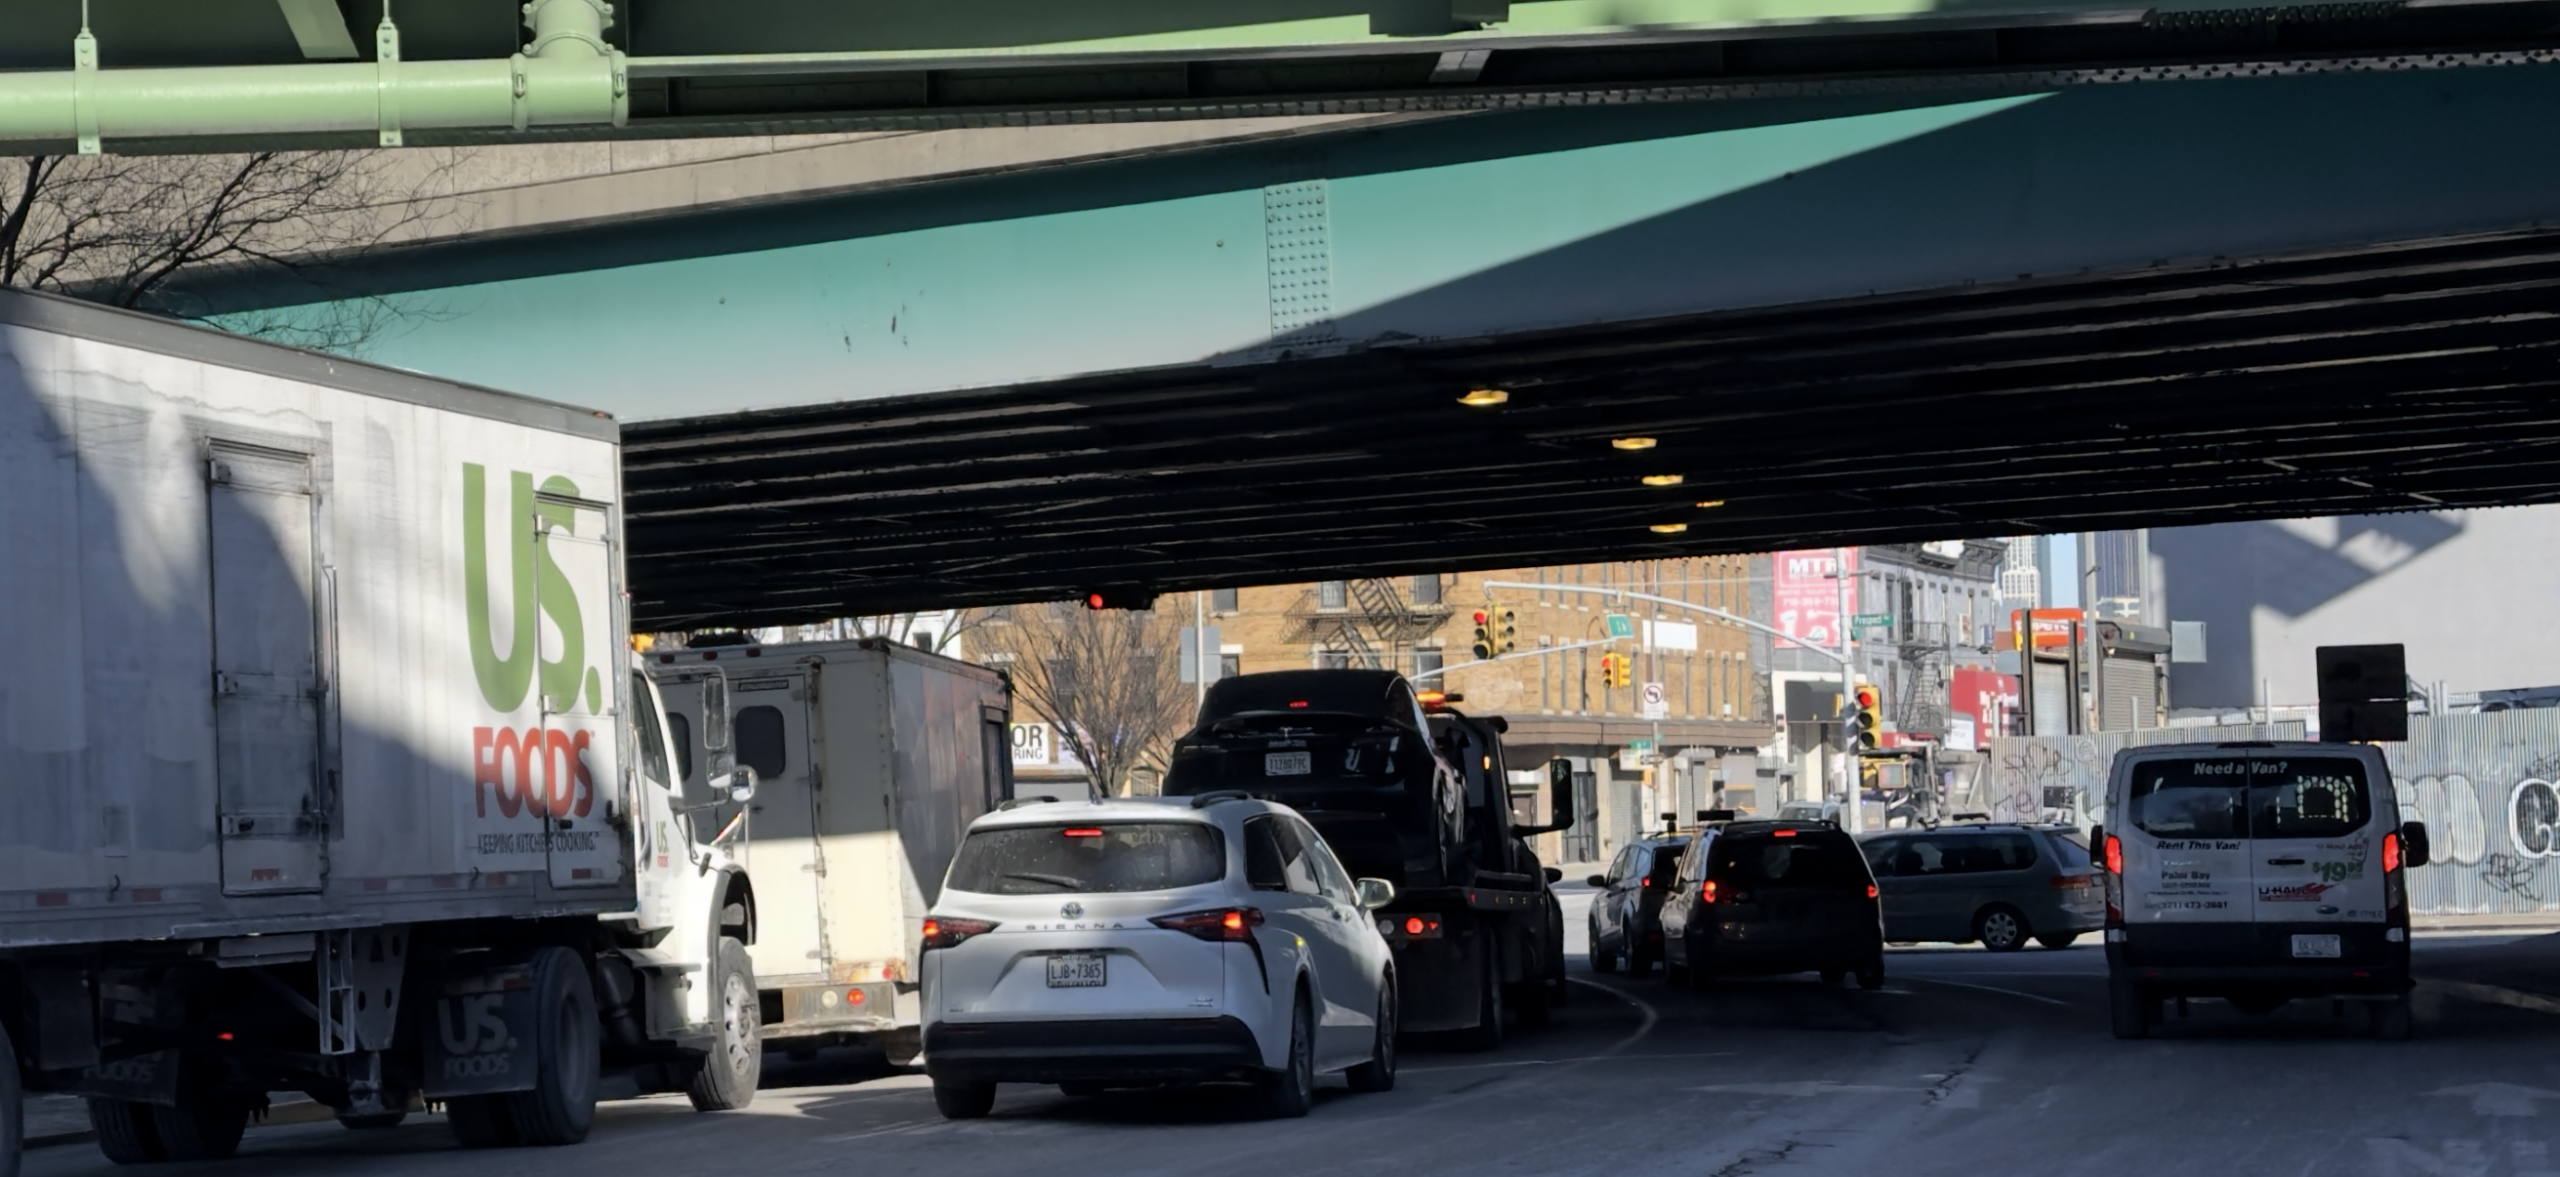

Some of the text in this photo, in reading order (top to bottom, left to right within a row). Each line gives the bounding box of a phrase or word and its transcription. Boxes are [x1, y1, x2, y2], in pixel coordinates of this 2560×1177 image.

[1855, 615, 1882, 626] Prospect
[474, 727, 593, 819] FOODS
[2194, 761, 2288, 775] Need a Van?
[478, 834, 514, 854] KEEPING
[516, 833, 554, 853] KITCHES
[2156, 840, 2241, 850] Rent This Van!
[1026, 923, 1124, 931] SIENNA
[444, 1053, 511, 1080] FOODS
